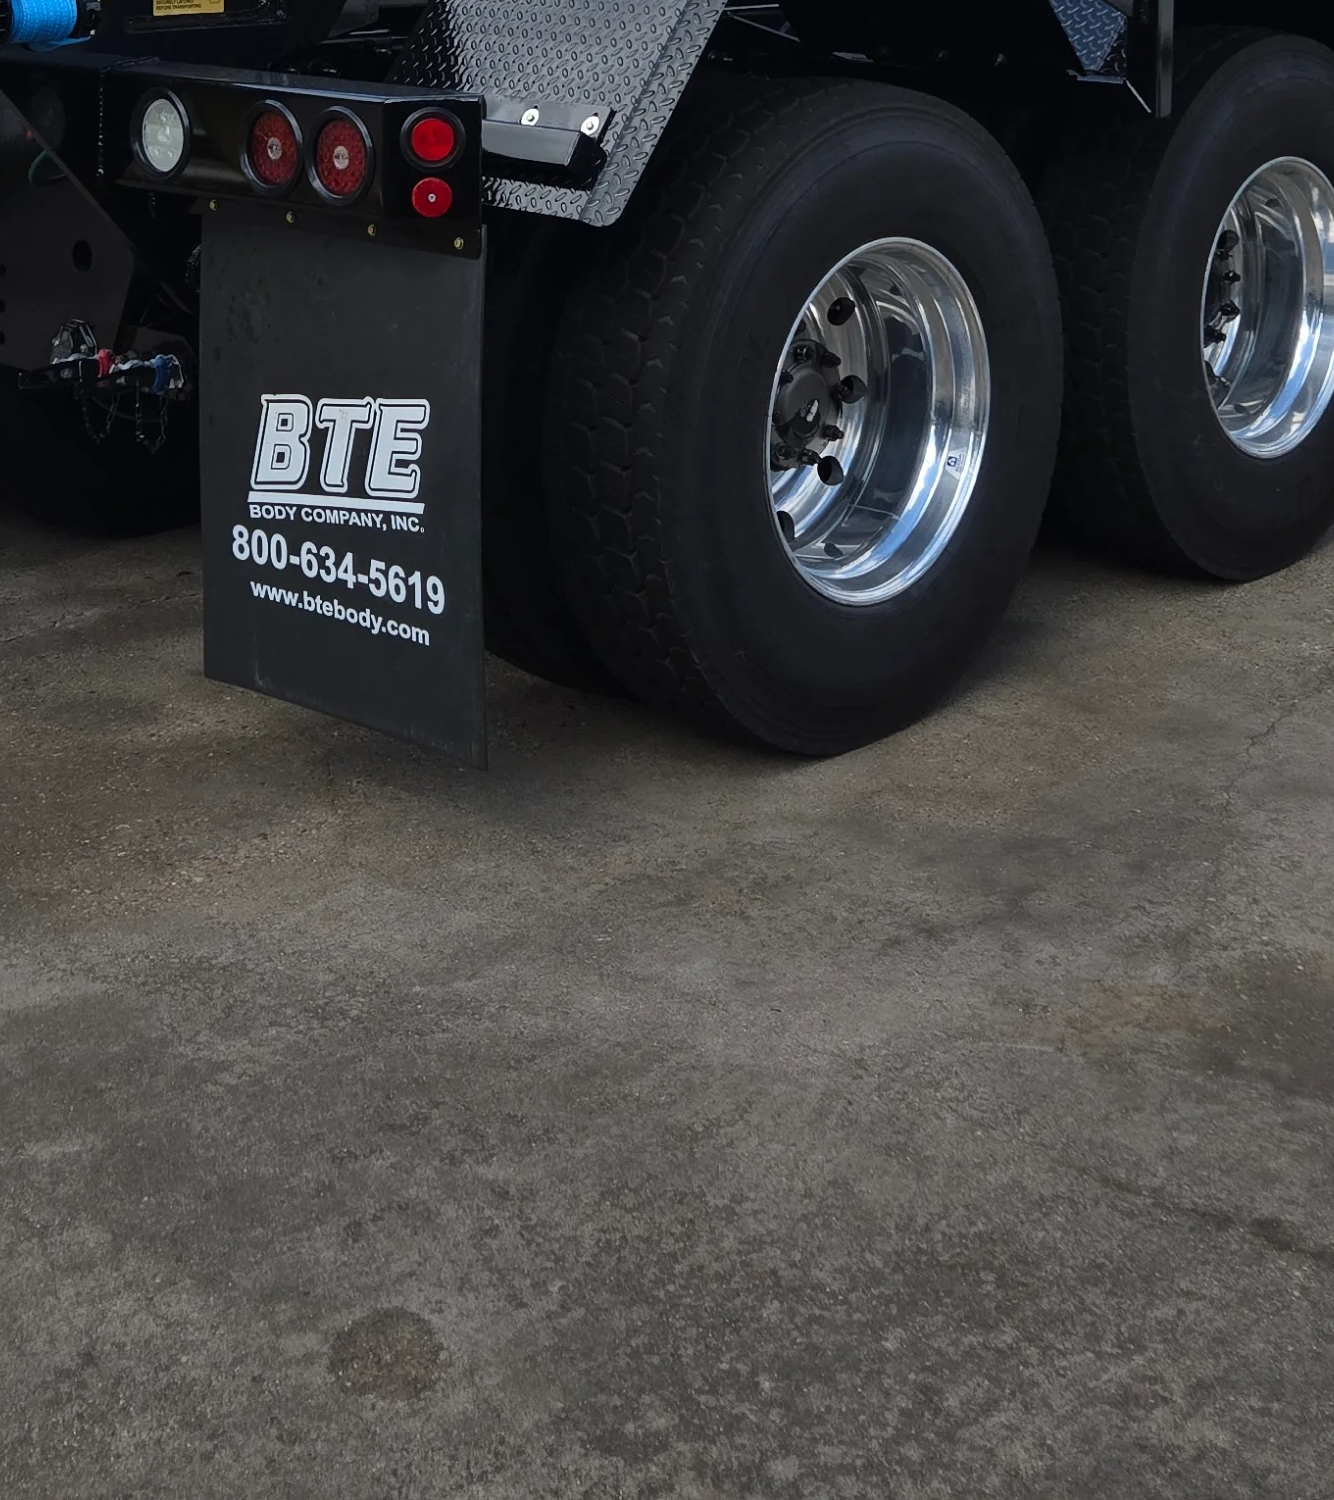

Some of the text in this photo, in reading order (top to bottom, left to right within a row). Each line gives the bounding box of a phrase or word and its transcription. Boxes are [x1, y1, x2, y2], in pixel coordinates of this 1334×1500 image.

[250, 393, 431, 499] BTE
[249, 504, 425, 533] BODY COMPANY, INC.
[232, 524, 445, 615] 800-634-5619
[250, 580, 430, 646] www.btebody.com
